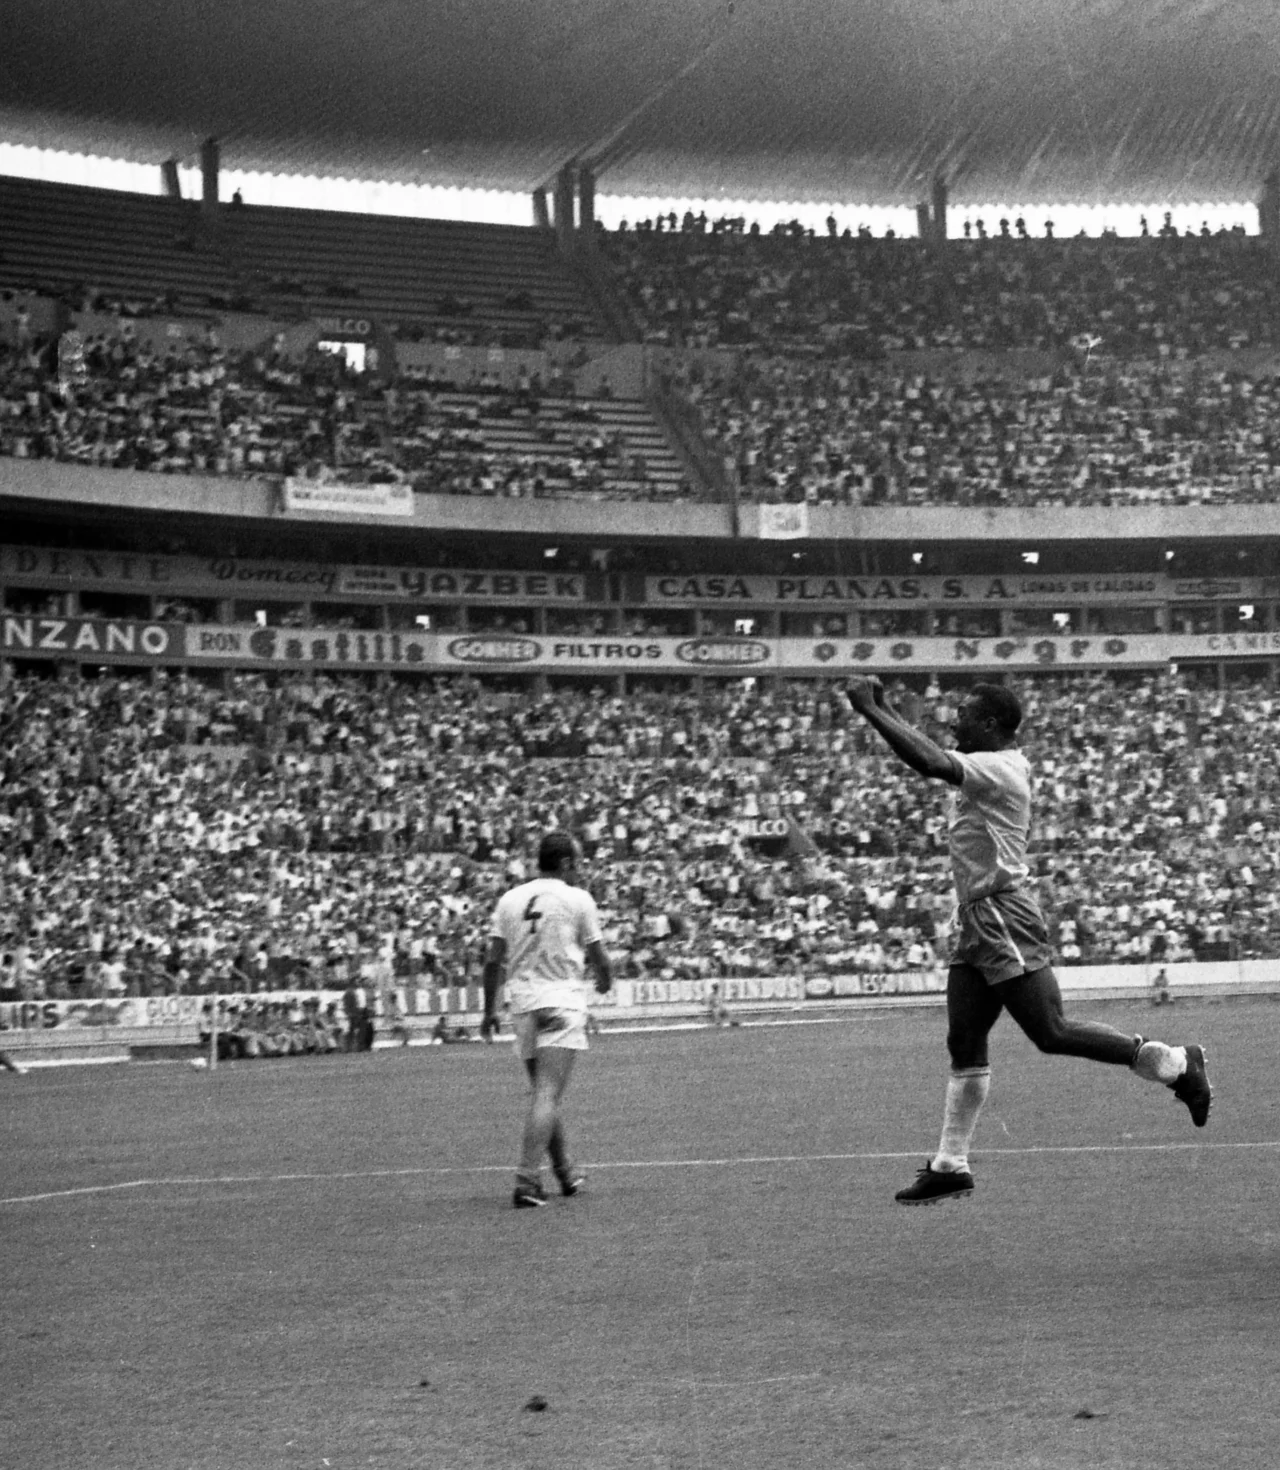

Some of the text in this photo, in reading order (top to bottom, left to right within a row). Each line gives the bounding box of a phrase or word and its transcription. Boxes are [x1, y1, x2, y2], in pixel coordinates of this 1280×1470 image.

[402, 571, 577, 597] YAZBEK
[657, 578, 752, 599] CASA
[5, 618, 169, 654] NZANO
[201, 632, 241, 652] RON
[554, 643, 662, 659] FILTROS
[523, 895, 543, 934] 4
